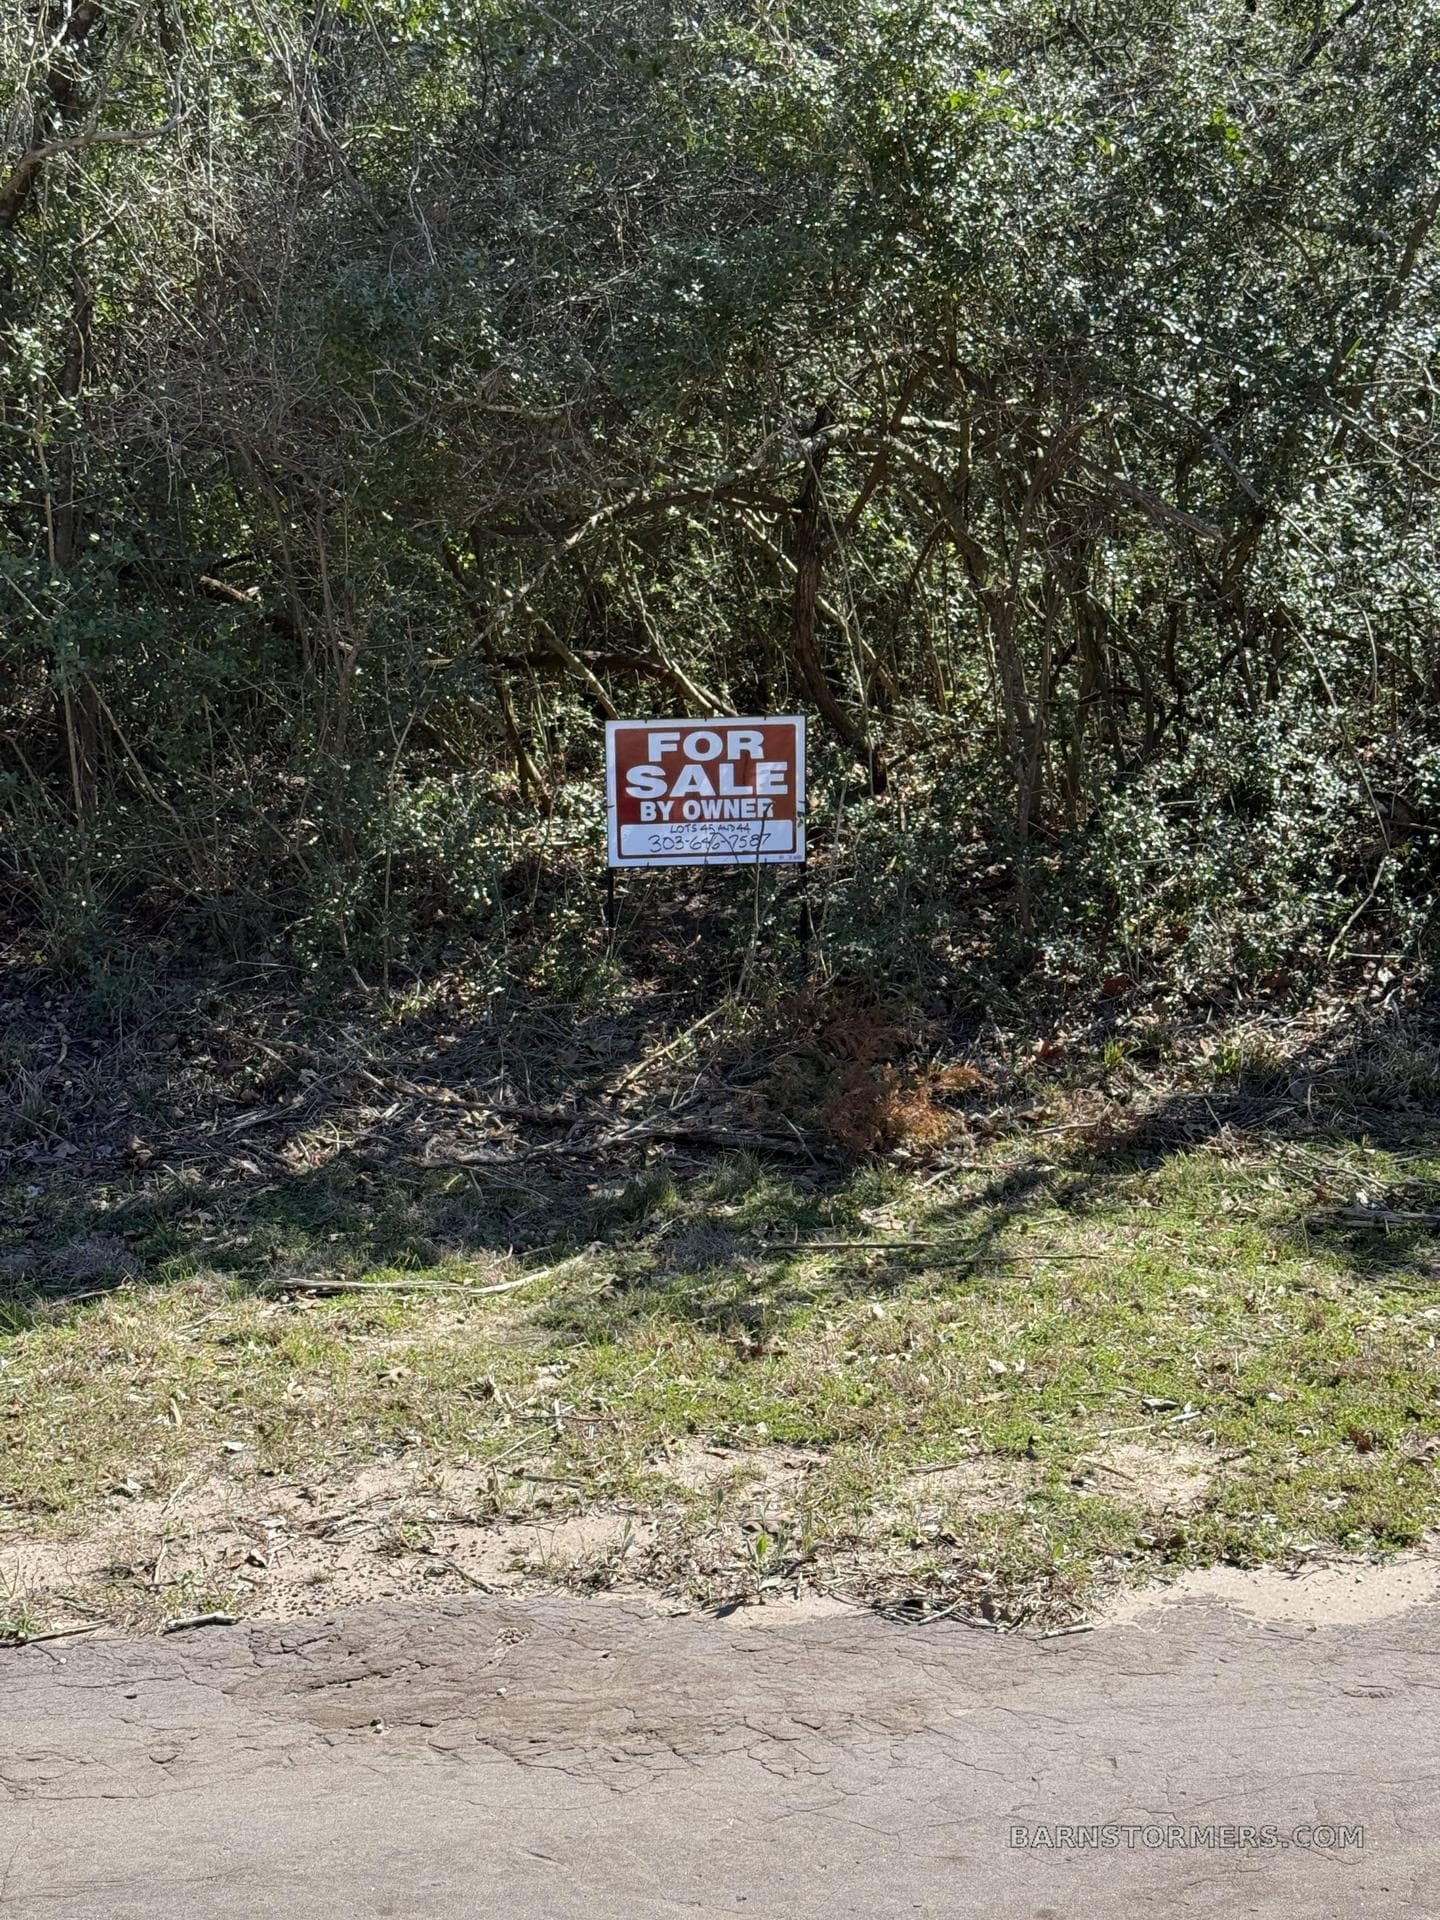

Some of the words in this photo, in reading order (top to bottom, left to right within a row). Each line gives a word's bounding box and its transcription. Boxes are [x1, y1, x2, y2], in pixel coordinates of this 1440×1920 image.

[648, 730, 764, 762] FOR
[625, 761, 788, 799] SALE
[640, 800, 675, 822] BY
[682, 798, 774, 821] OWNER
[670, 824, 697, 834] LOTS
[718, 823, 735, 833] AND
